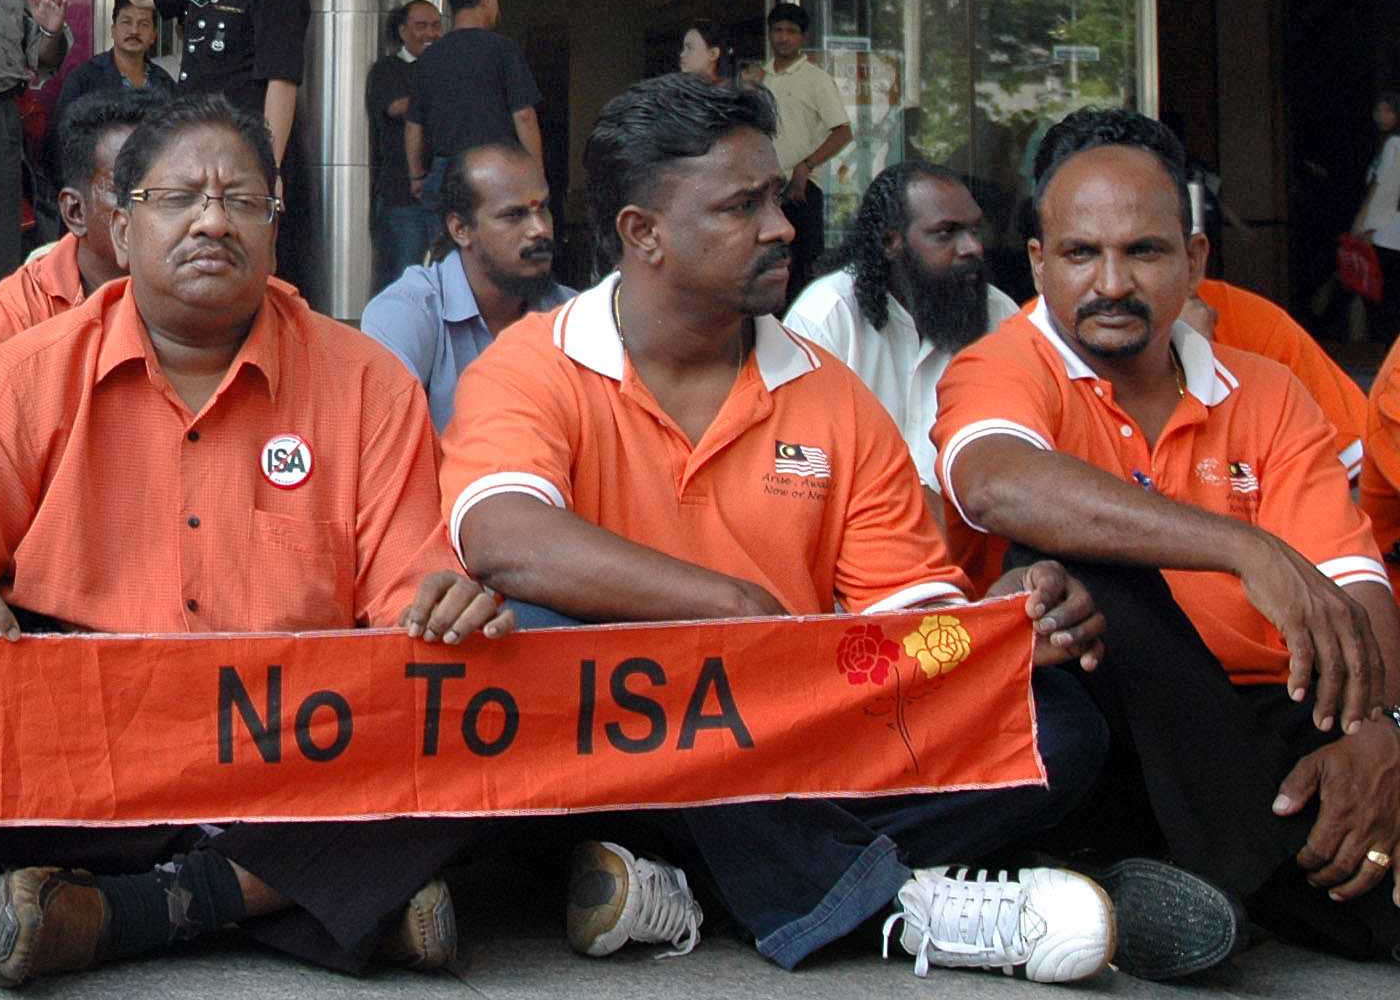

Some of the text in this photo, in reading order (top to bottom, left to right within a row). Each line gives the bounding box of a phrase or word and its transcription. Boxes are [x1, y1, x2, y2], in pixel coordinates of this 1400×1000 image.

[267, 448, 307, 473] ISA
[218, 656, 755, 765] No To ISA
